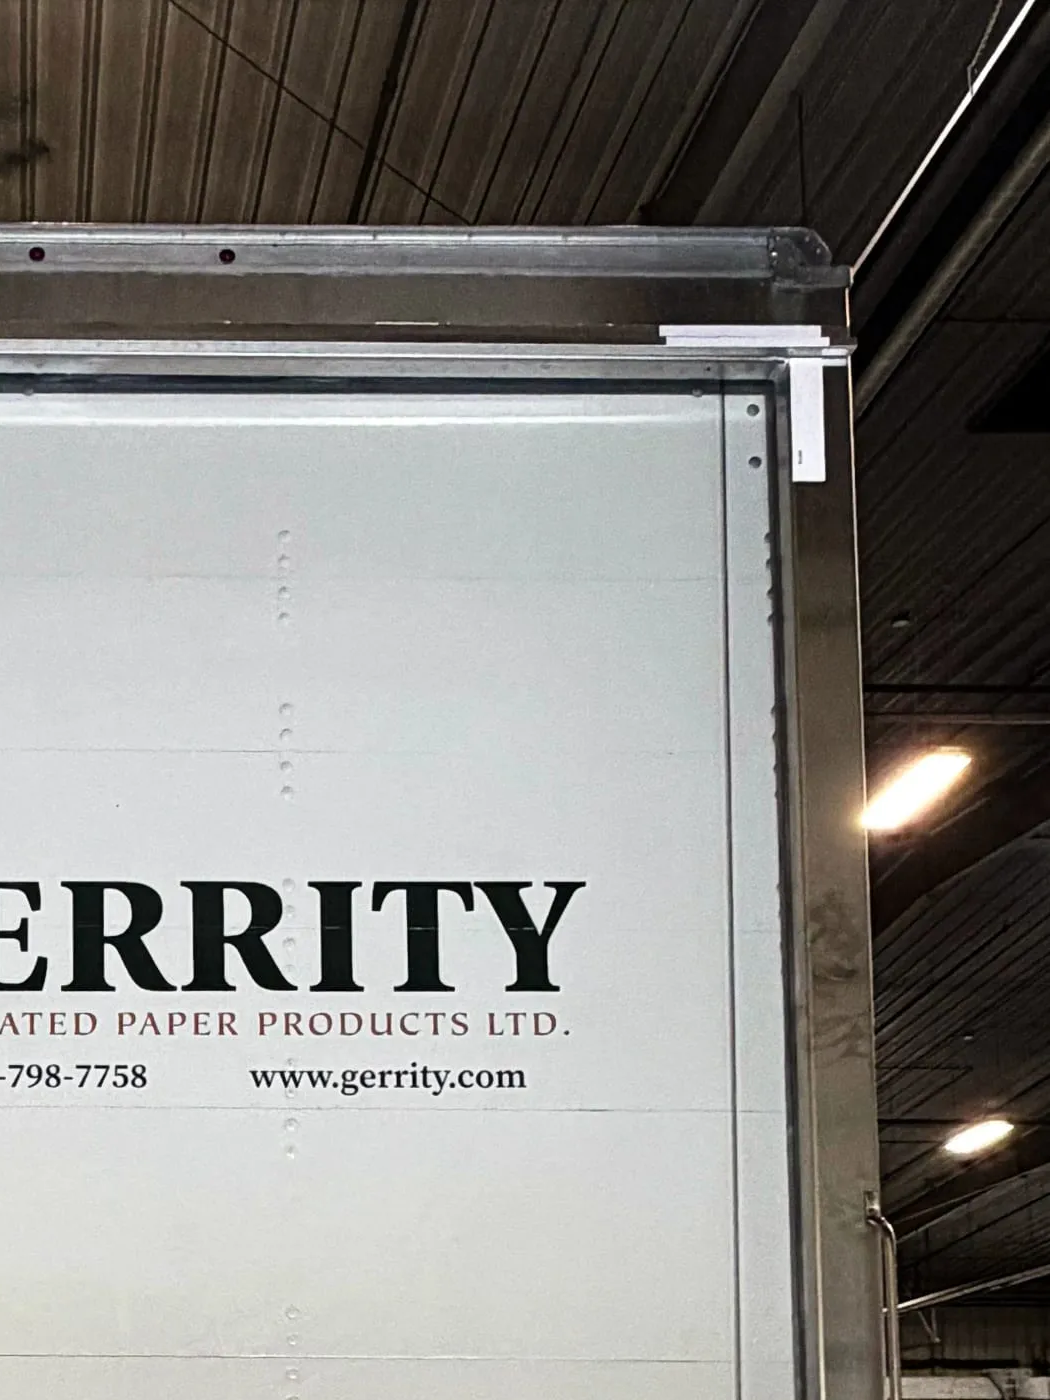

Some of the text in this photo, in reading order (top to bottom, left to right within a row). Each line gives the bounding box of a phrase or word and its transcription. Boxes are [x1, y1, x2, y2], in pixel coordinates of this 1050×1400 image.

[118, 1012, 238, 1036] PAPER
[259, 1012, 468, 1037] PRODUCTS
[489, 1012, 571, 1037] LTD.
[249, 1062, 527, 1097] www.gerrity.com
